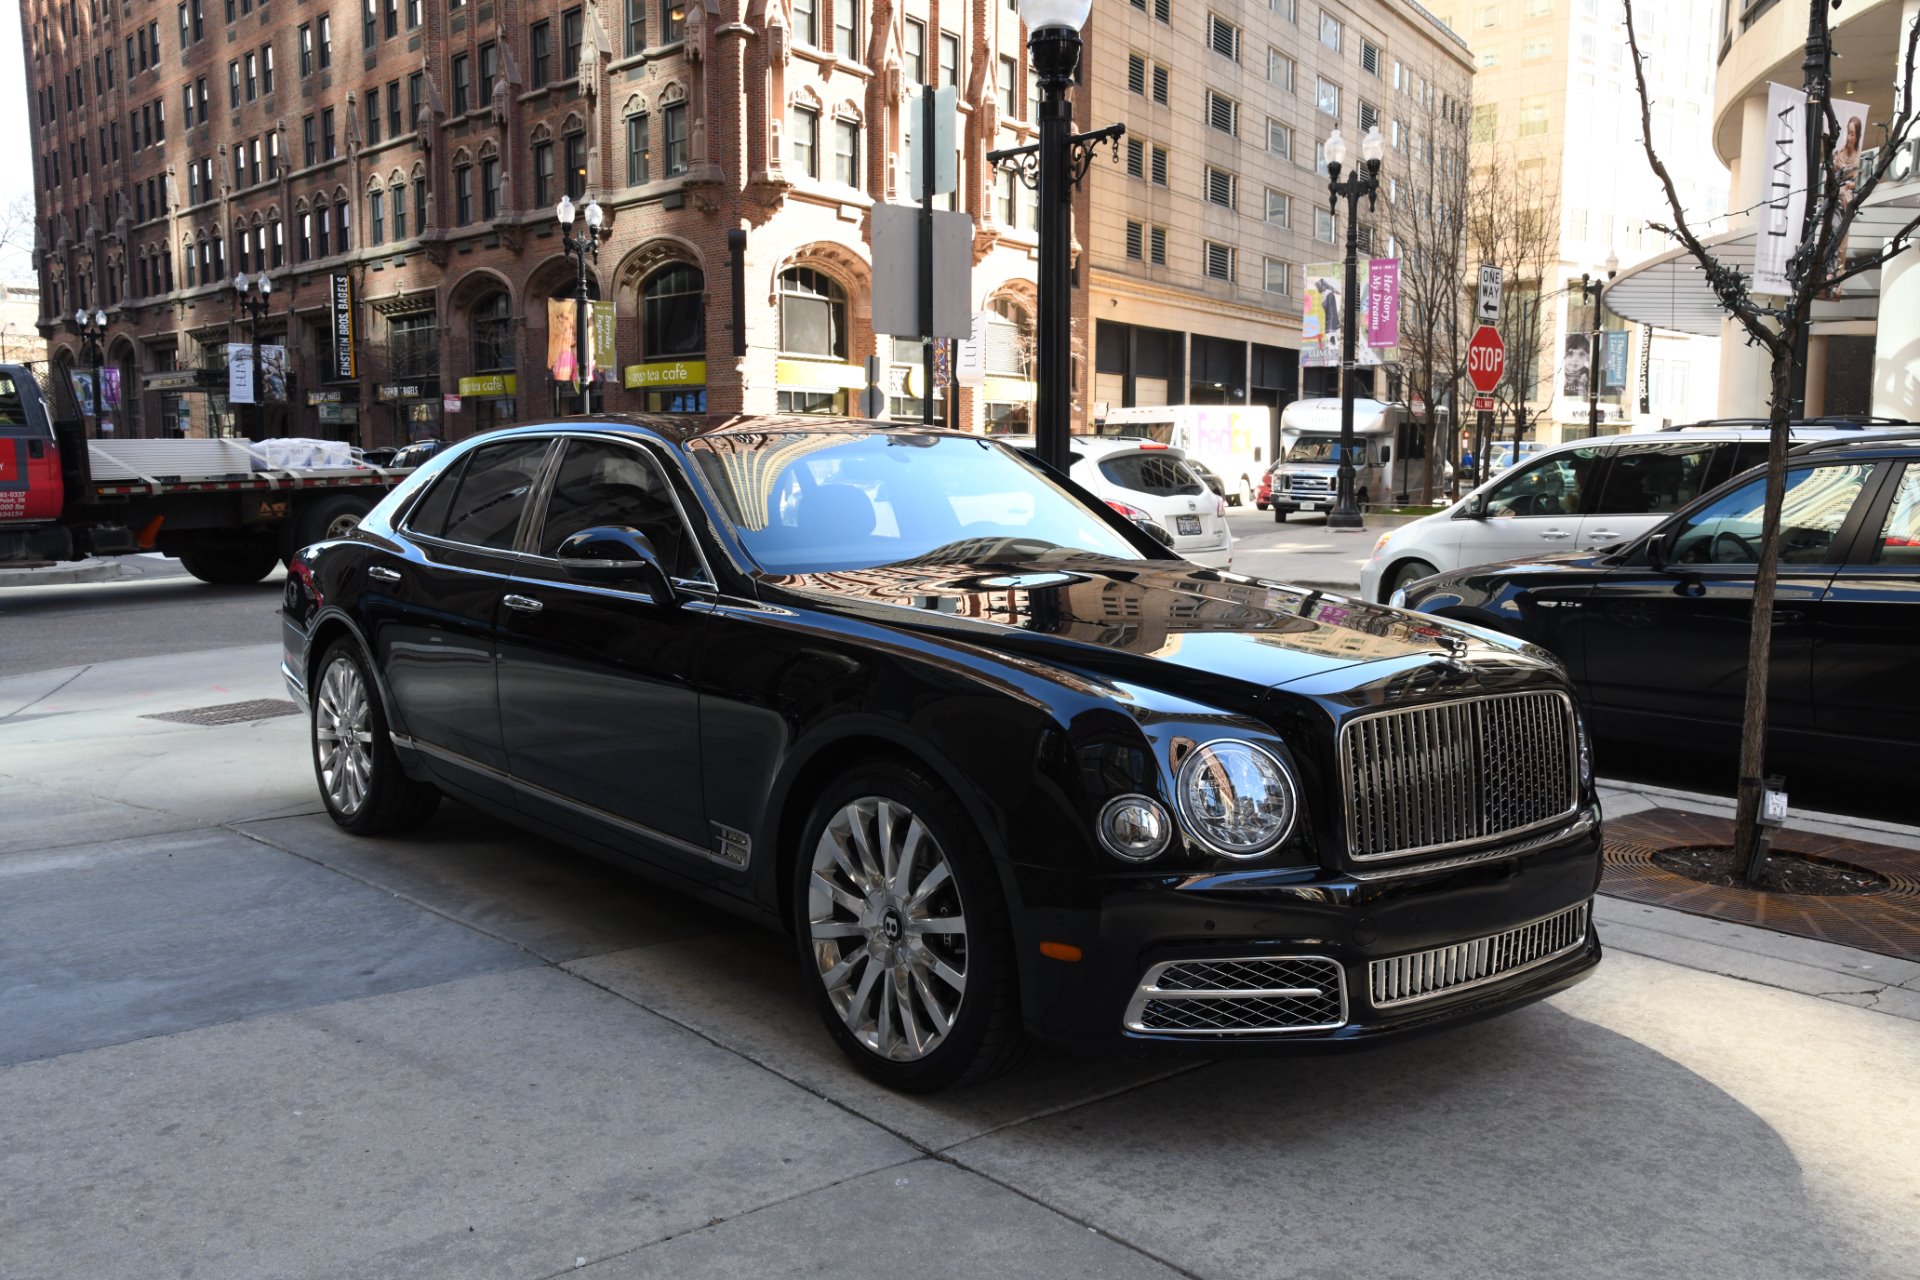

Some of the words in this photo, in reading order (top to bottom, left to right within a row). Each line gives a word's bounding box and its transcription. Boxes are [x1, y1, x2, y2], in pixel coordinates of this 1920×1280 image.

[1767, 105, 1795, 237] LUMA
[1371, 275, 1381, 290] My
[1384, 274, 1393, 292] Her
[1483, 270, 1500, 285] ONE
[336, 276, 349, 310] BAGELS
[1482, 285, 1500, 299] WAY
[1372, 293, 1381, 330] Dreams
[1382, 295, 1393, 322] Story,
[596, 314, 604, 355] Englewood
[604, 315, 612, 349] Everyday
[339, 337, 351, 376] EINSTEIN
[1470, 346, 1502, 372] STOP
[662, 363, 687, 380] café
[1476, 399, 1484, 408] ALL
[1484, 399, 1493, 409] WAY
[1198, 411, 1253, 455] FedEx
